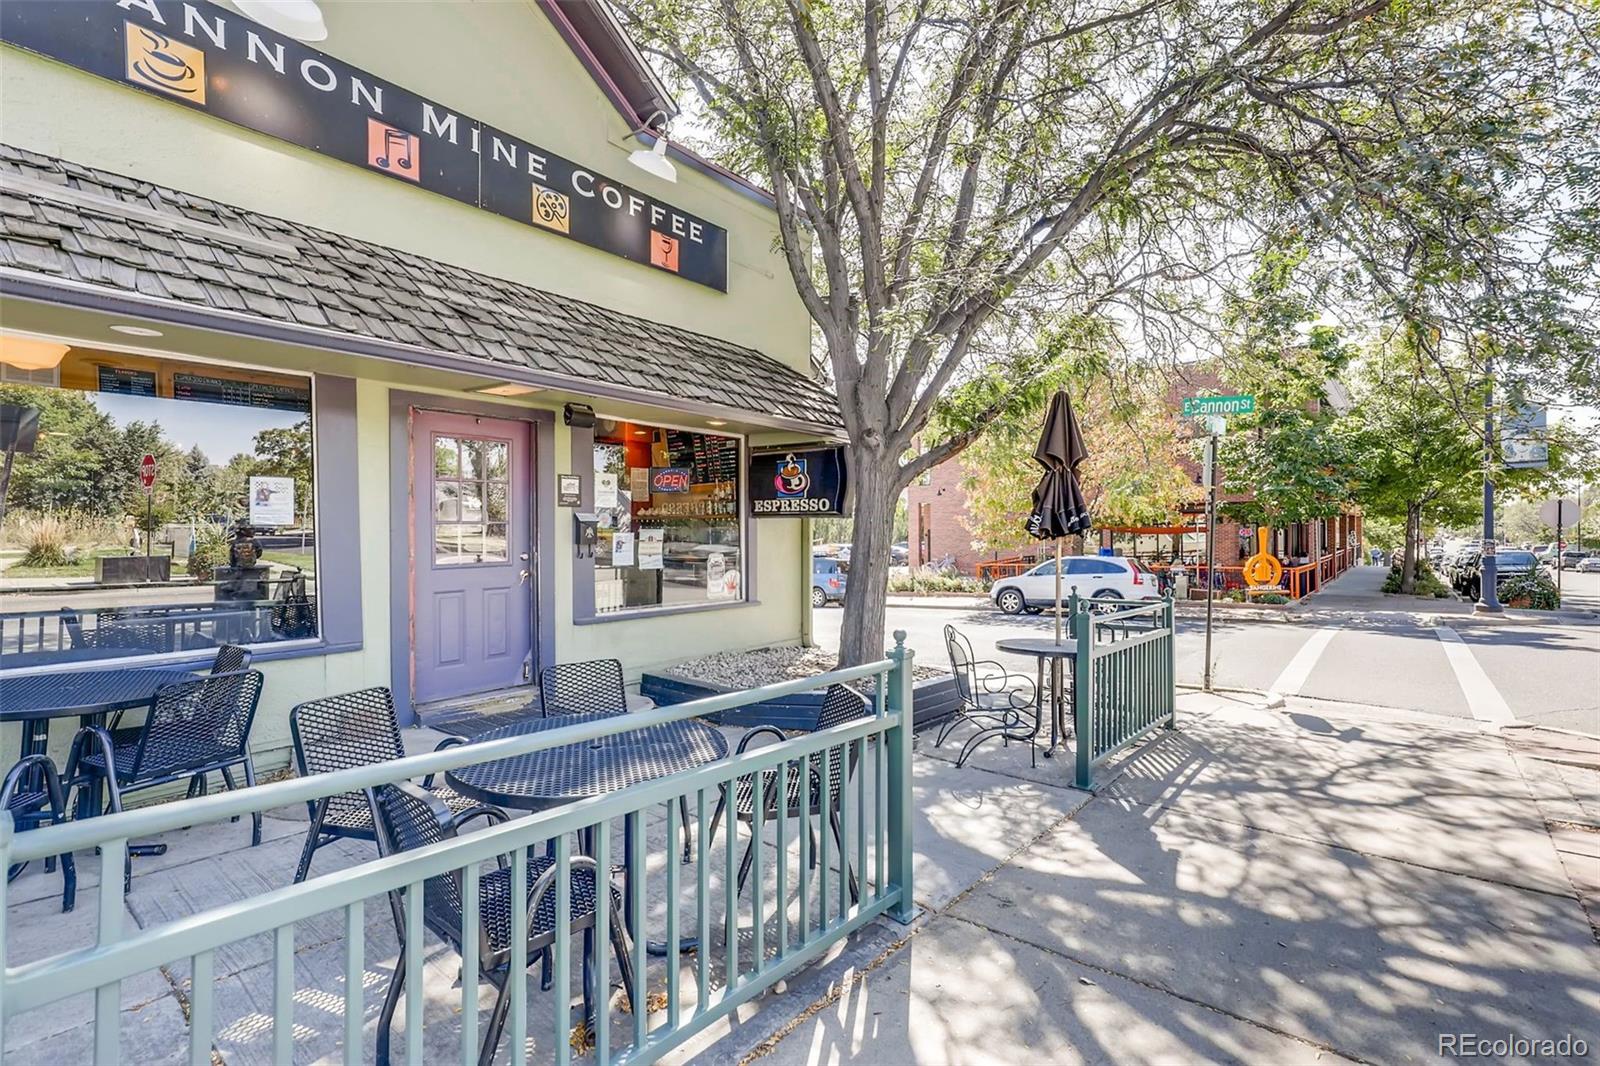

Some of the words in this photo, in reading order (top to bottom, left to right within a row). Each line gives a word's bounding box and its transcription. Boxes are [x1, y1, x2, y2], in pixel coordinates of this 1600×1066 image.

[422, 103, 547, 180] MINE
[571, 170, 703, 244] COFFEE
[1184, 402, 1190, 412] E
[1192, 399, 1239, 413] Cannon
[1241, 399, 1251, 409] St
[654, 474, 688, 488] OPEN
[754, 498, 830, 512] ESPRESSO
